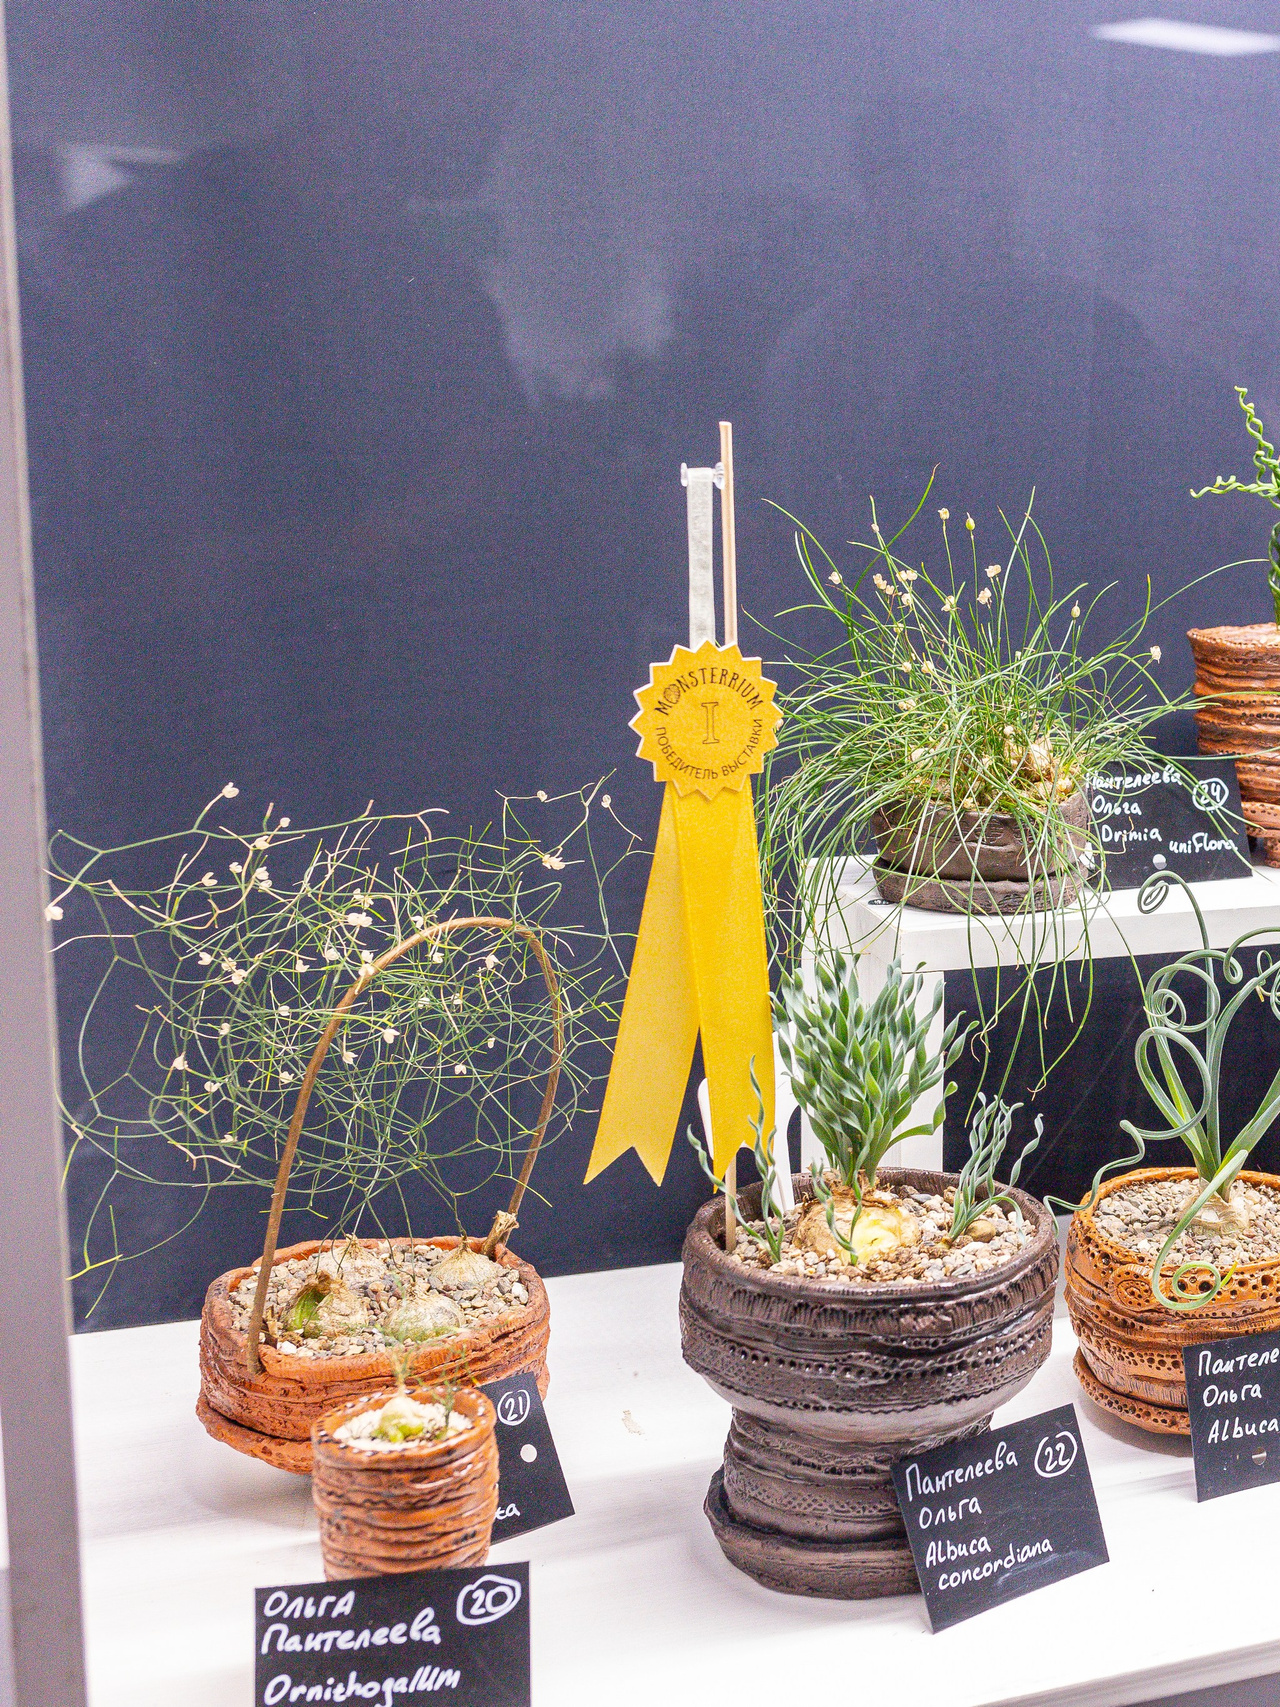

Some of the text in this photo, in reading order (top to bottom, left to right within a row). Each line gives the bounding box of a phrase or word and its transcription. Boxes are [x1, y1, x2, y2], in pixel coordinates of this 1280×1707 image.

[654, 667, 764, 716] MONSTERRIUM
[655, 718, 763, 780] ПОБЕДИТЕЛЬ ВЫСТАВКИ
[1092, 795, 1142, 815] Ольга
[1200, 783, 1221, 804] 24
[1102, 825, 1162, 842] Drimia
[504, 1396, 524, 1421] 21
[1203, 1383, 1262, 1407] Ольга
[1207, 1417, 1280, 1444] Albuca
[905, 1441, 1018, 1502] Пантелеева
[1044, 1442, 1071, 1472] 22
[918, 1497, 982, 1530] Ольга
[925, 1537, 991, 1568] Albuca
[938, 1538, 1053, 1590] concordiana
[469, 1588, 513, 1614] 20
[261, 1607, 442, 1655] Пантелеева
